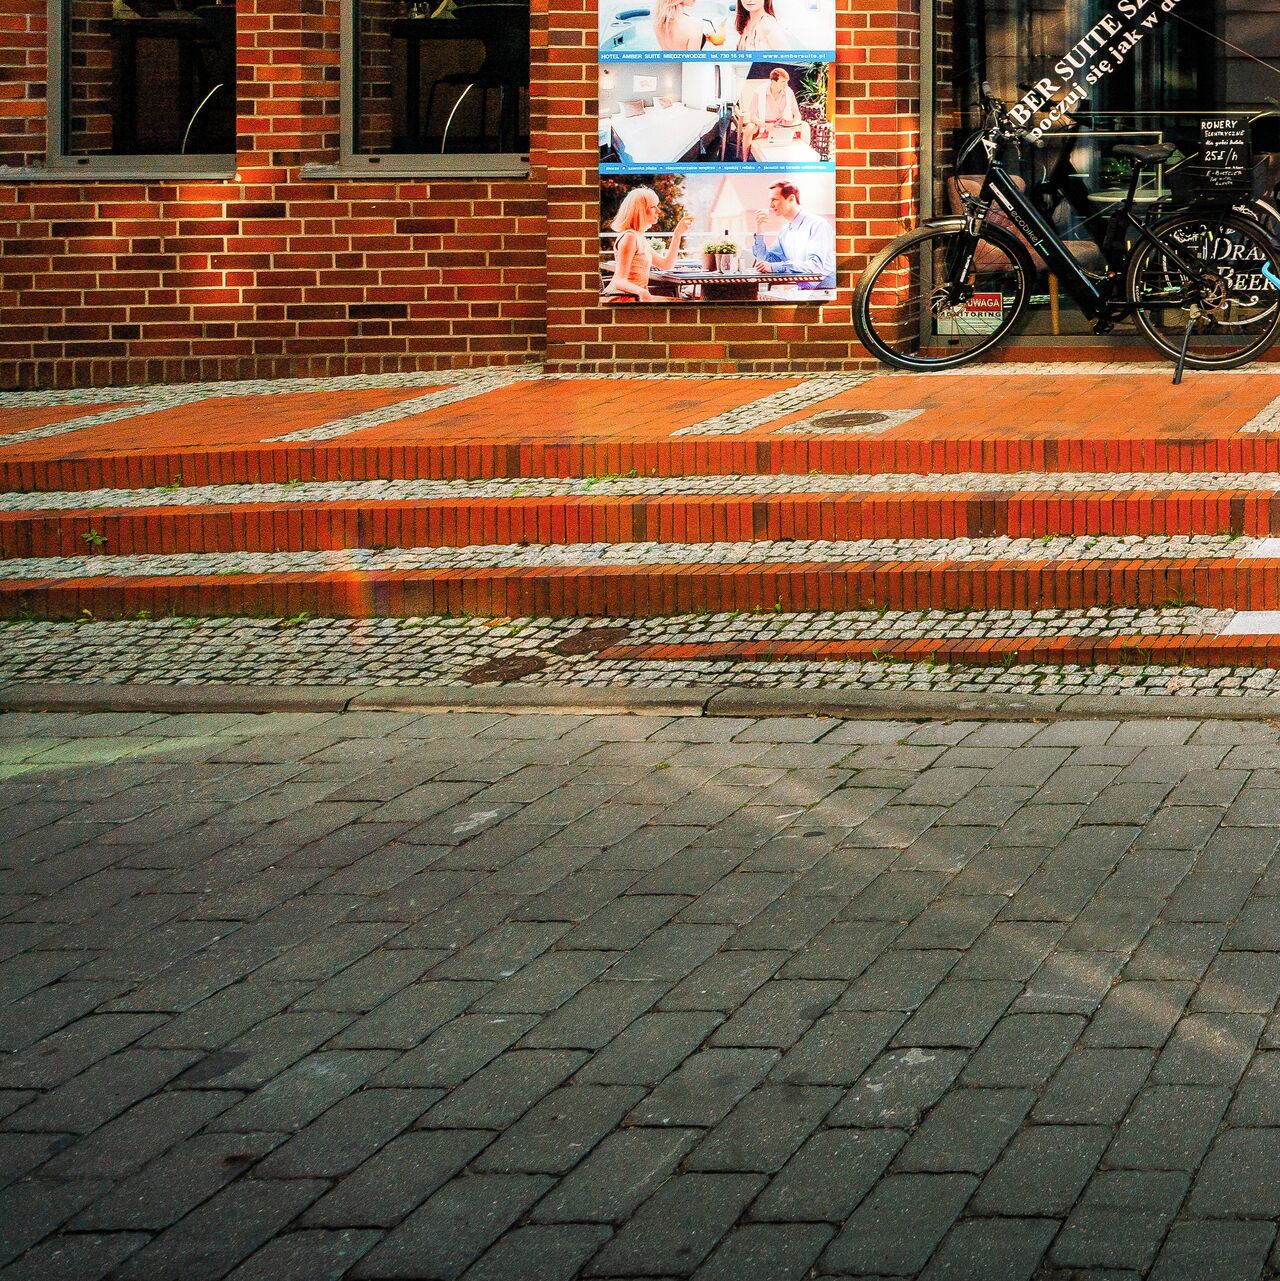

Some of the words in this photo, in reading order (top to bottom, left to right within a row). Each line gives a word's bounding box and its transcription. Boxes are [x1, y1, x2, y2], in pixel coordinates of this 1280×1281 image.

[981, 78, 1060, 159] ABER
[1054, 13, 1123, 82] SUITE
[1030, 81, 1088, 140] poczuj
[1085, 58, 1114, 85] się
[1108, 27, 1144, 64] jak
[1140, 11, 1160, 29] w
[1201, 120, 1238, 129] ROWERY
[1010, 210, 1038, 243] ecobike
[967, 299, 1000, 307] UWAGA
